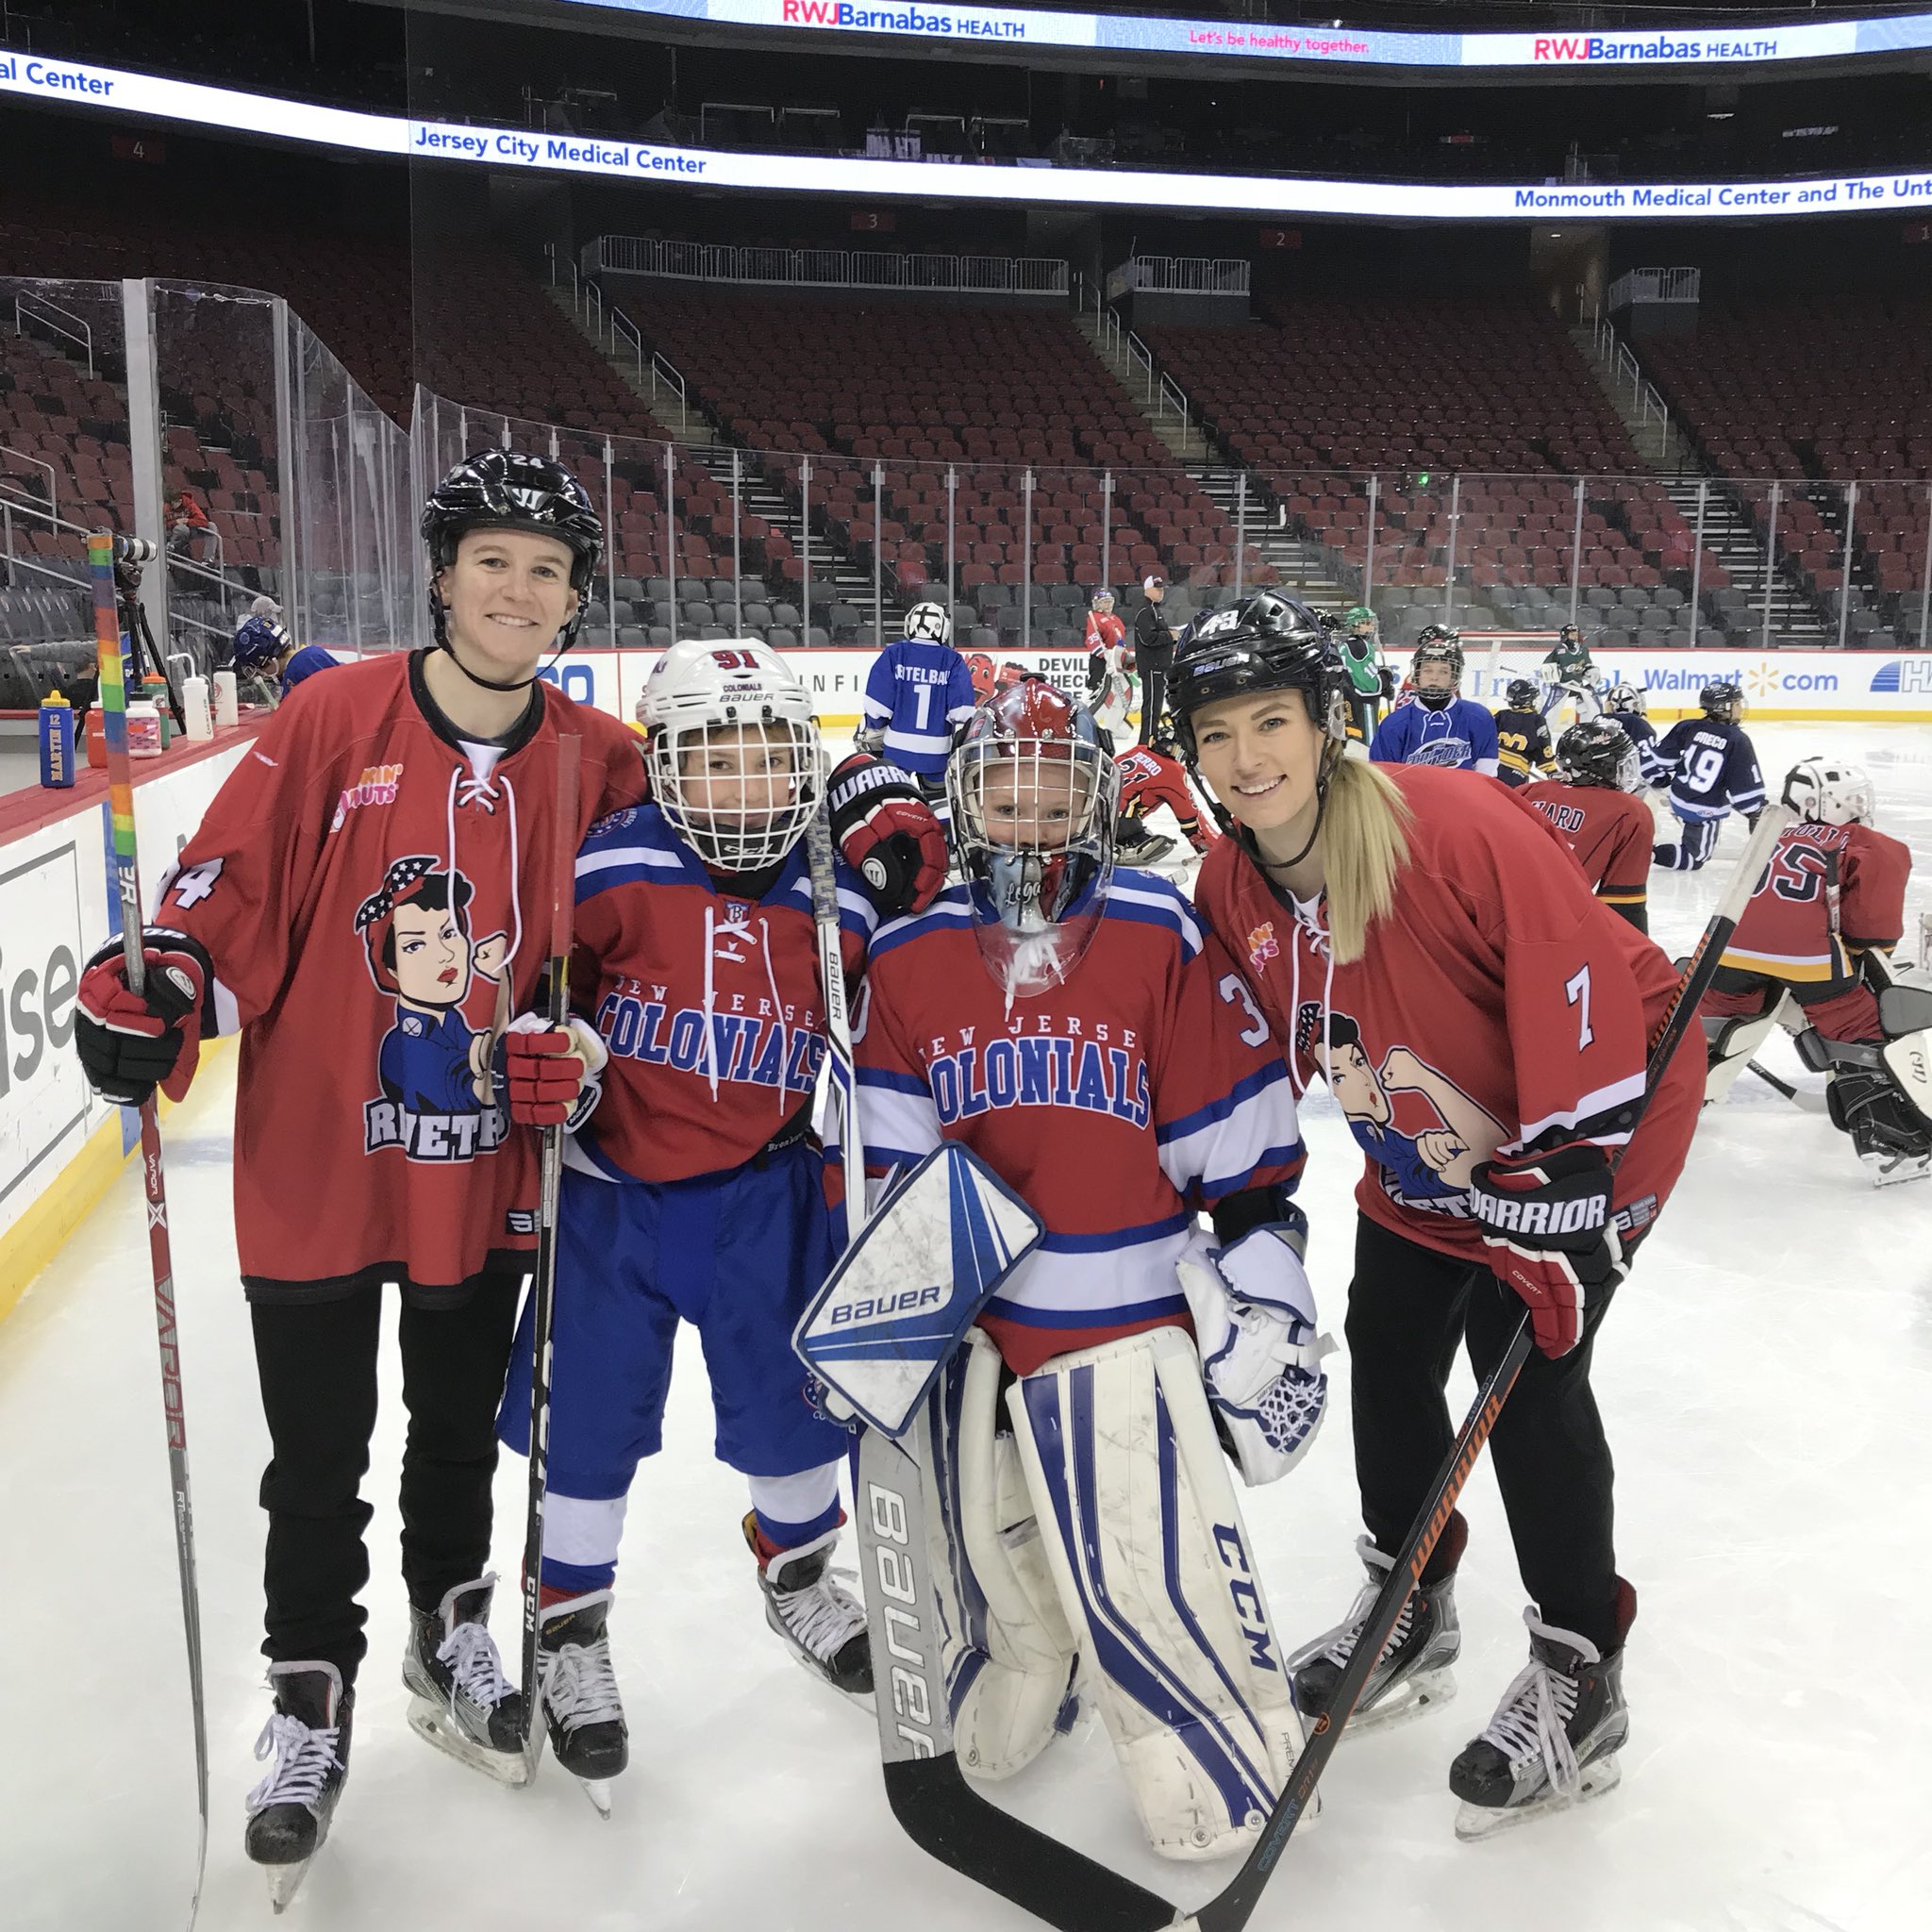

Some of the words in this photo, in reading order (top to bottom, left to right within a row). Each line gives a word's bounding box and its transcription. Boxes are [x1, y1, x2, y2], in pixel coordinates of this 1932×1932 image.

[957, 19, 1025, 38] HEALTH
[1190, 29, 1223, 44] Let's
[1226, 31, 1245, 46] be
[1249, 33, 1301, 53] healthy
[1305, 39, 1370, 55] together.
[1534, 36, 1702, 60] RWJBarnabas
[1706, 41, 1777, 58] HEALTH
[25, 62, 114, 95] Center
[132, 142, 145, 158] 4
[415, 126, 488, 158] Jersey
[496, 135, 540, 162] City
[547, 141, 630, 167] Medical
[636, 150, 708, 174] Center
[1515, 189, 1625, 208] Monmouth
[1633, 188, 1712, 207] Medical
[1718, 188, 1790, 206] Center
[1797, 183, 1838, 203] and
[1845, 181, 1885, 200] The
[868, 213, 878, 229] 3
[1276, 232, 1286, 246] 2
[510, 454, 545, 469] 24
[711, 650, 760, 671] 91
[1039, 658, 1088, 672] DEVIL
[723, 683, 762, 692] COLONIALS
[1783, 675, 1838, 691] com
[719, 693, 774, 703] BAUER
[914, 684, 931, 730] 1
[1693, 731, 1727, 750] GRECO
[49, 729, 64, 782] MARTIN
[1133, 752, 1162, 776] PERRO
[895, 809, 929, 824] COVERT
[829, 951, 841, 1020] BAUER
[1219, 973, 1271, 1047] 3
[1565, 963, 1593, 1053] 7
[595, 992, 827, 1094] COLONIALS
[147, 1153, 158, 1196] VAPOR
[1469, 1184, 1607, 1235] WARRIOR
[1511, 1270, 1542, 1296] COVERT
[831, 1286, 941, 1325] BAUER
[154, 1274, 187, 1451] VAPOR
[525, 1575, 537, 1633] CCM
[1211, 1522, 1278, 1673] CCM
[868, 1481, 936, 1761] BAUER
